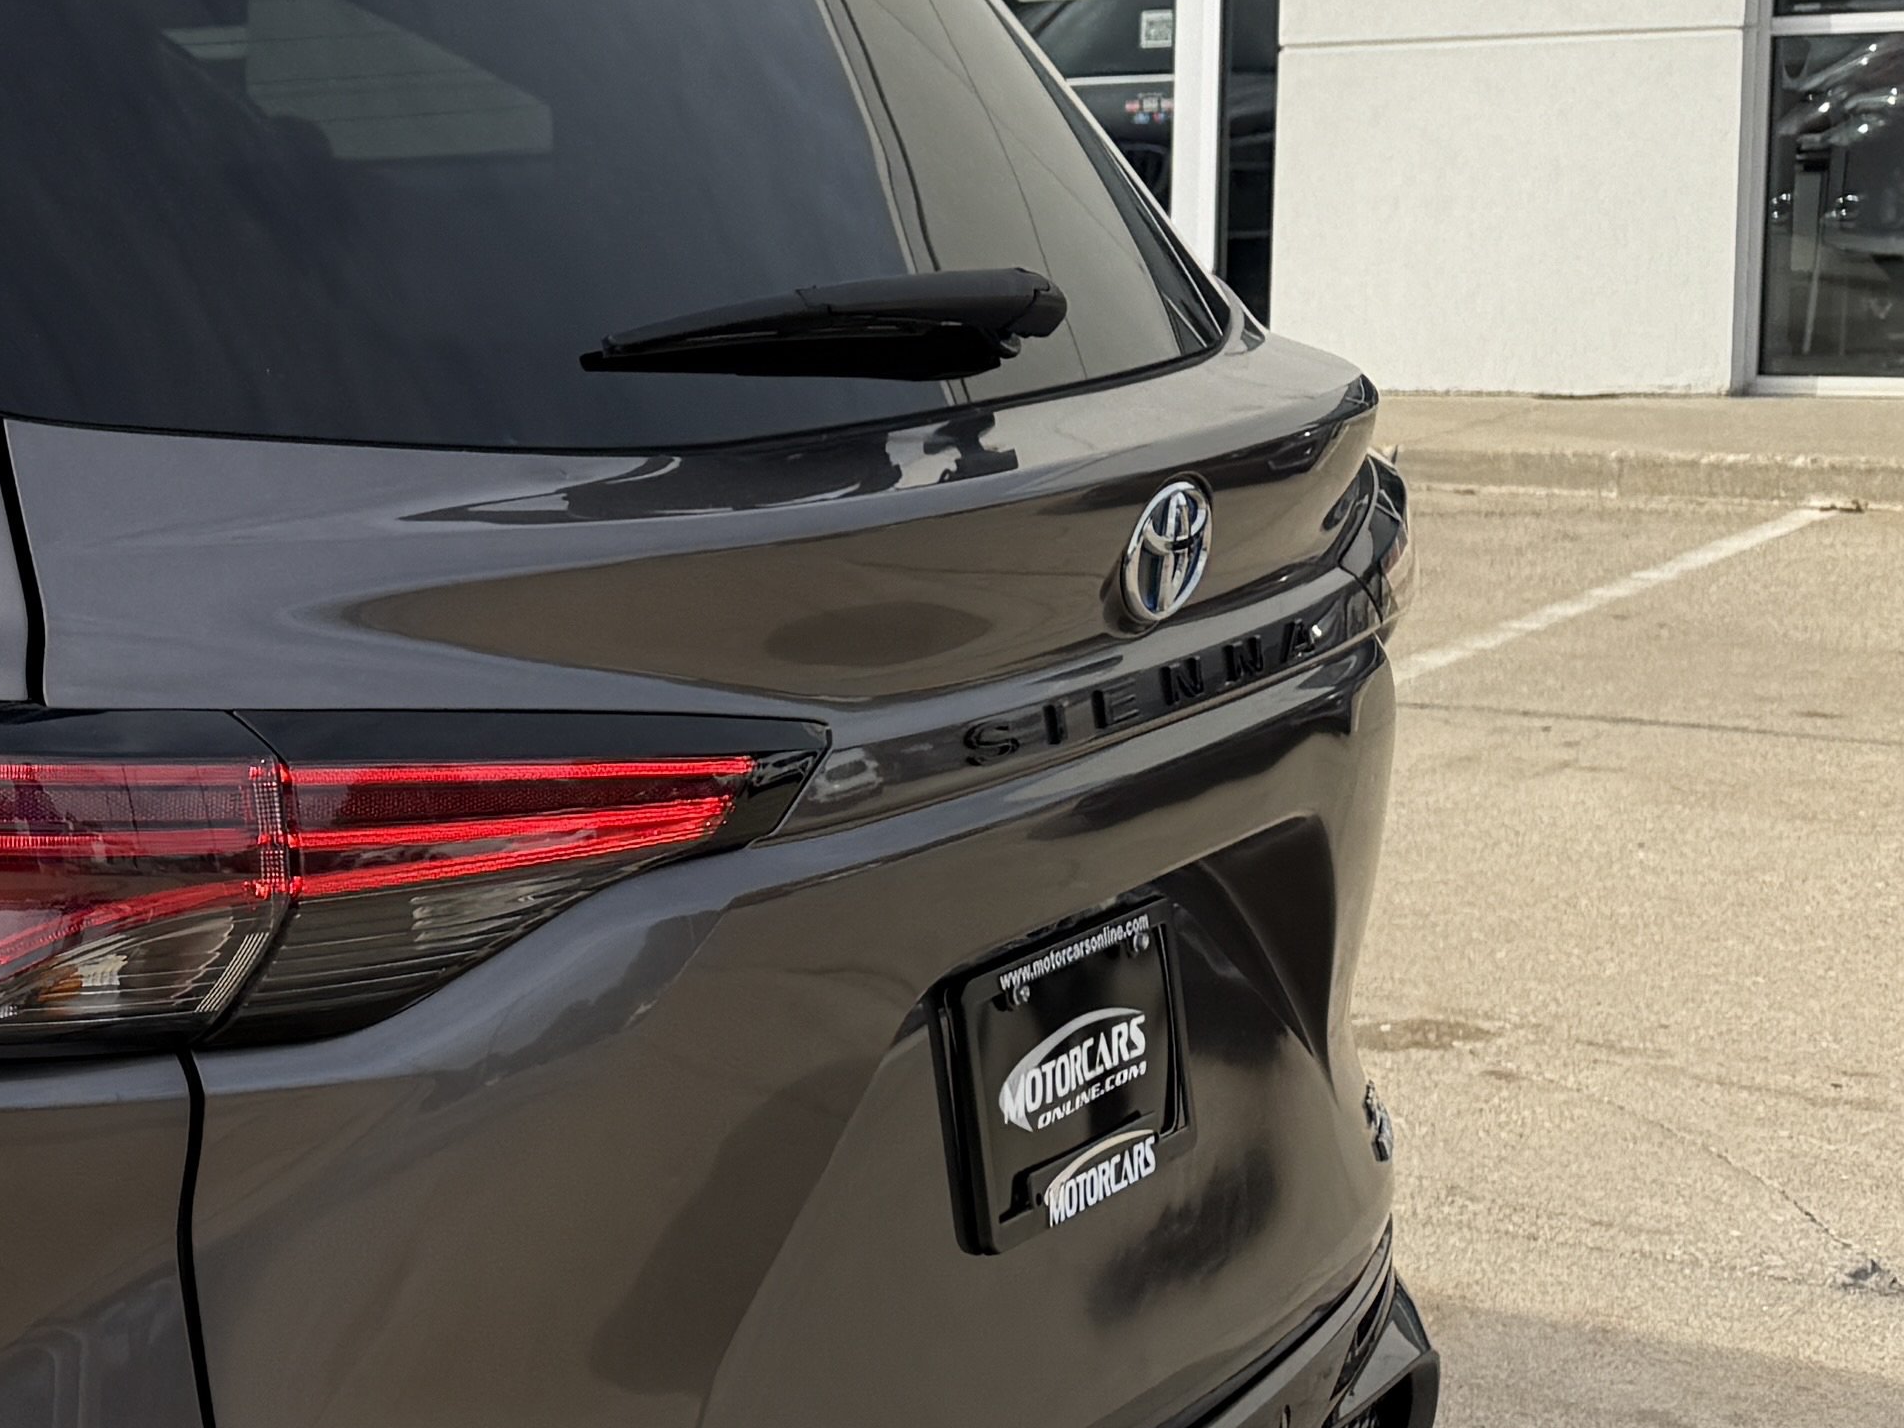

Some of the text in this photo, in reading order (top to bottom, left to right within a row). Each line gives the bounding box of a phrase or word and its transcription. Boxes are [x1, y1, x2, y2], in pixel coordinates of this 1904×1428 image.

[963, 618, 1320, 767] SIENNA
[999, 914, 1149, 990] www.motorcarsonline.com
[1003, 1013, 1147, 1125] MOTORCARS
[1036, 1060, 1148, 1130] ONLINE.COM
[1049, 1135, 1156, 1228] MOTORCARS
